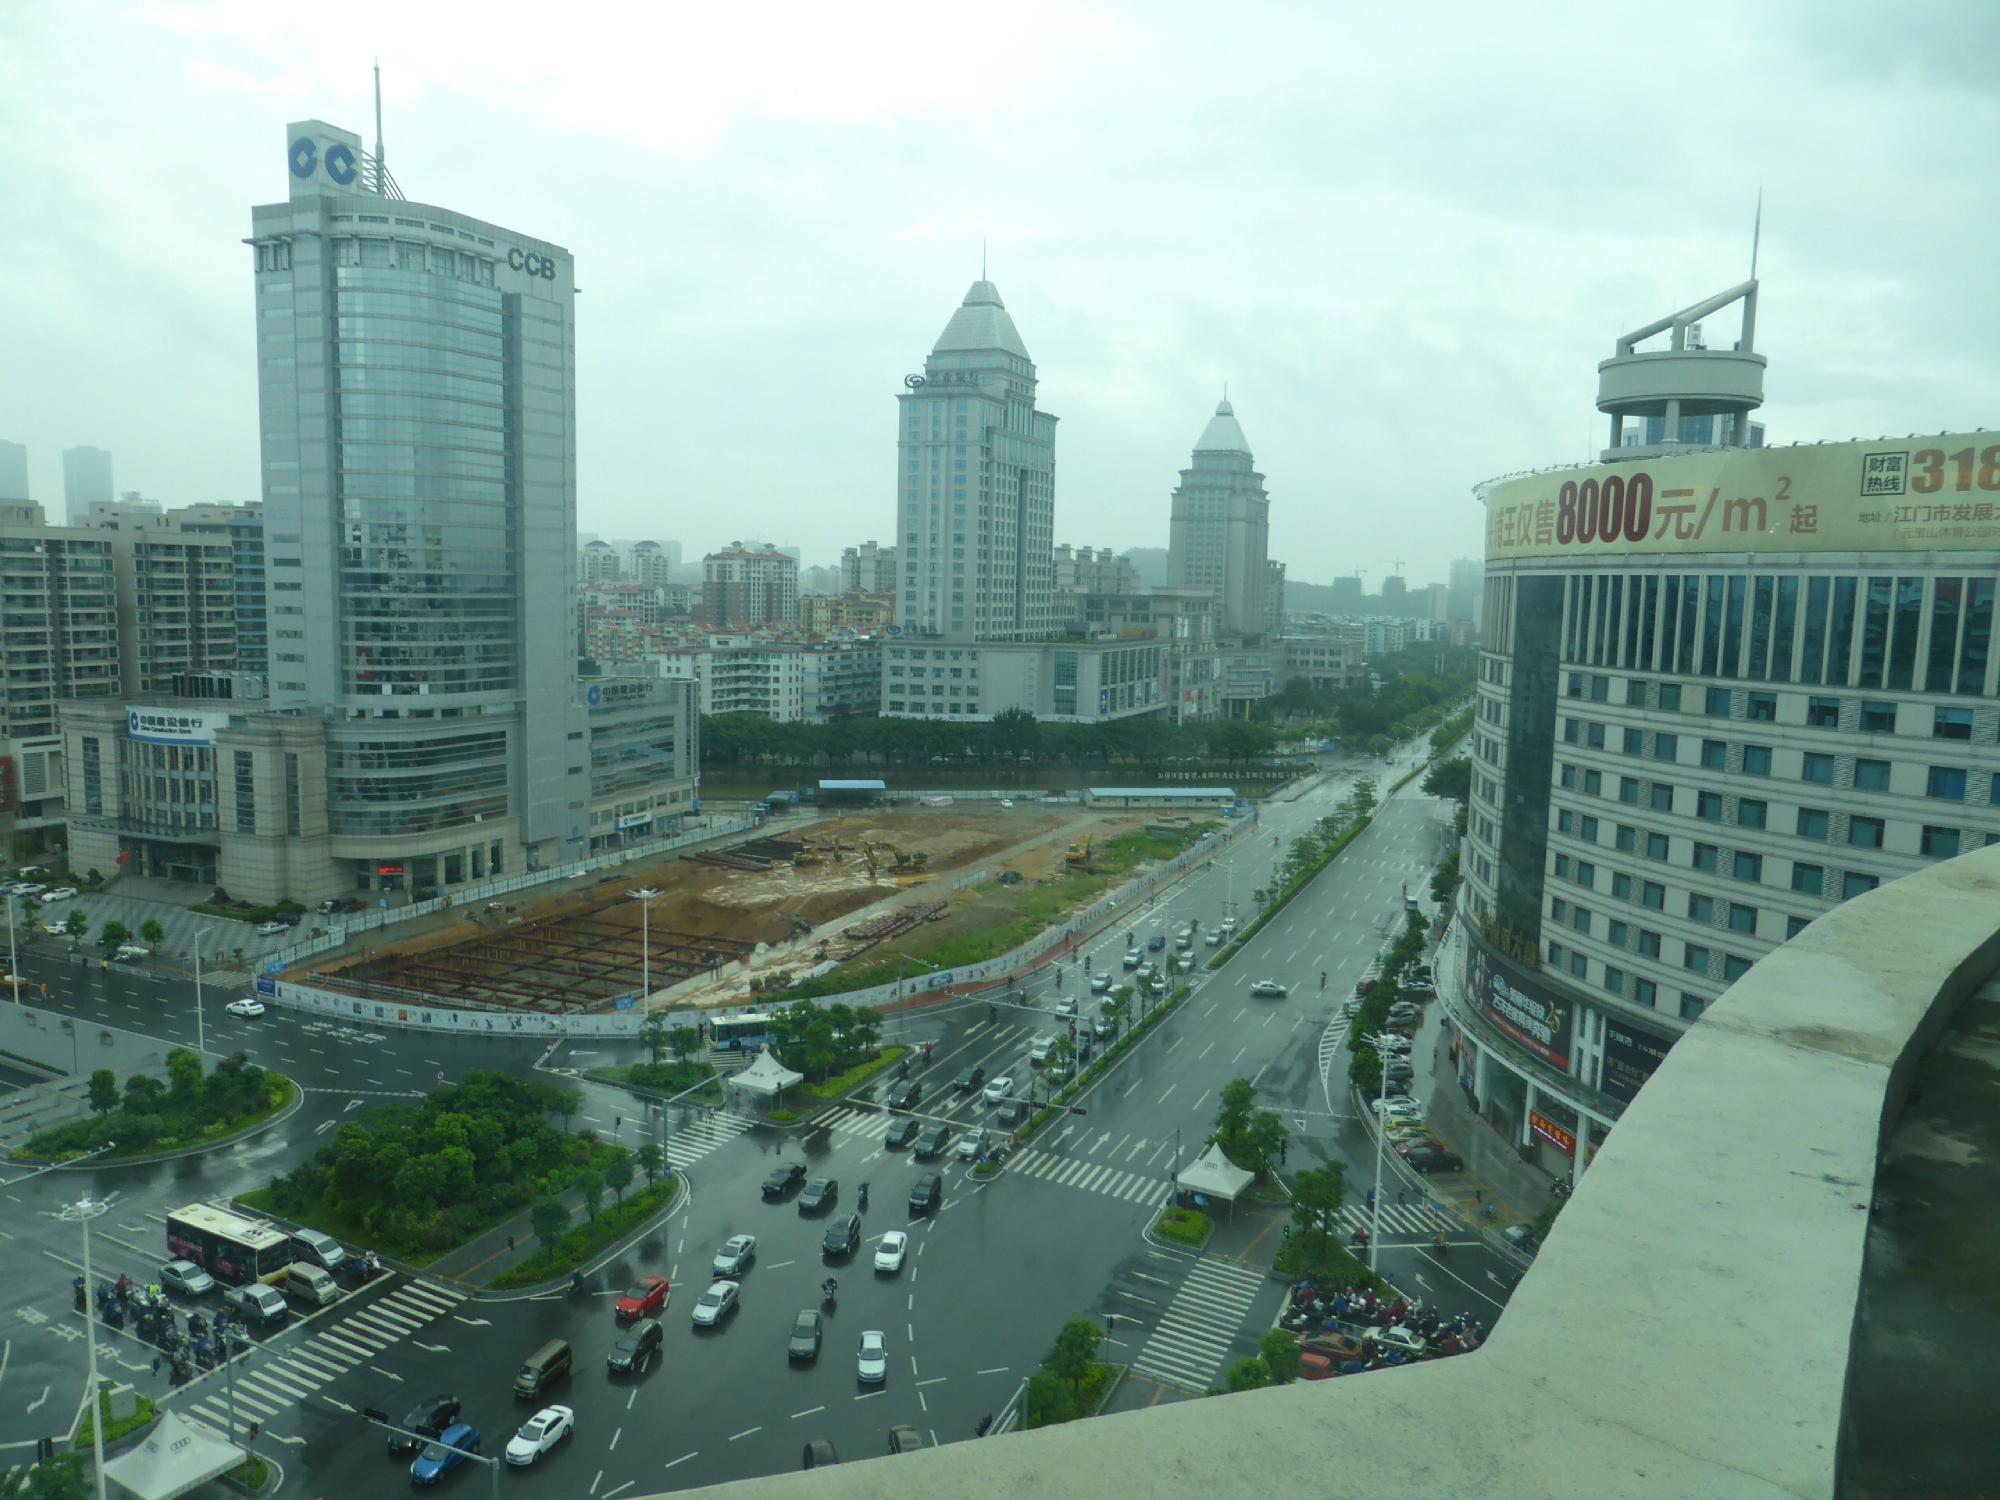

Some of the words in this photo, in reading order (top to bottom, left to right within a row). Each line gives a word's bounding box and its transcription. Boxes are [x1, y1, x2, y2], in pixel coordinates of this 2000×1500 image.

[508, 248, 556, 281] CCB
[1868, 456, 1902, 473] 财富
[1911, 444, 2000, 494] 318
[1866, 476, 1901, 492] 热线
